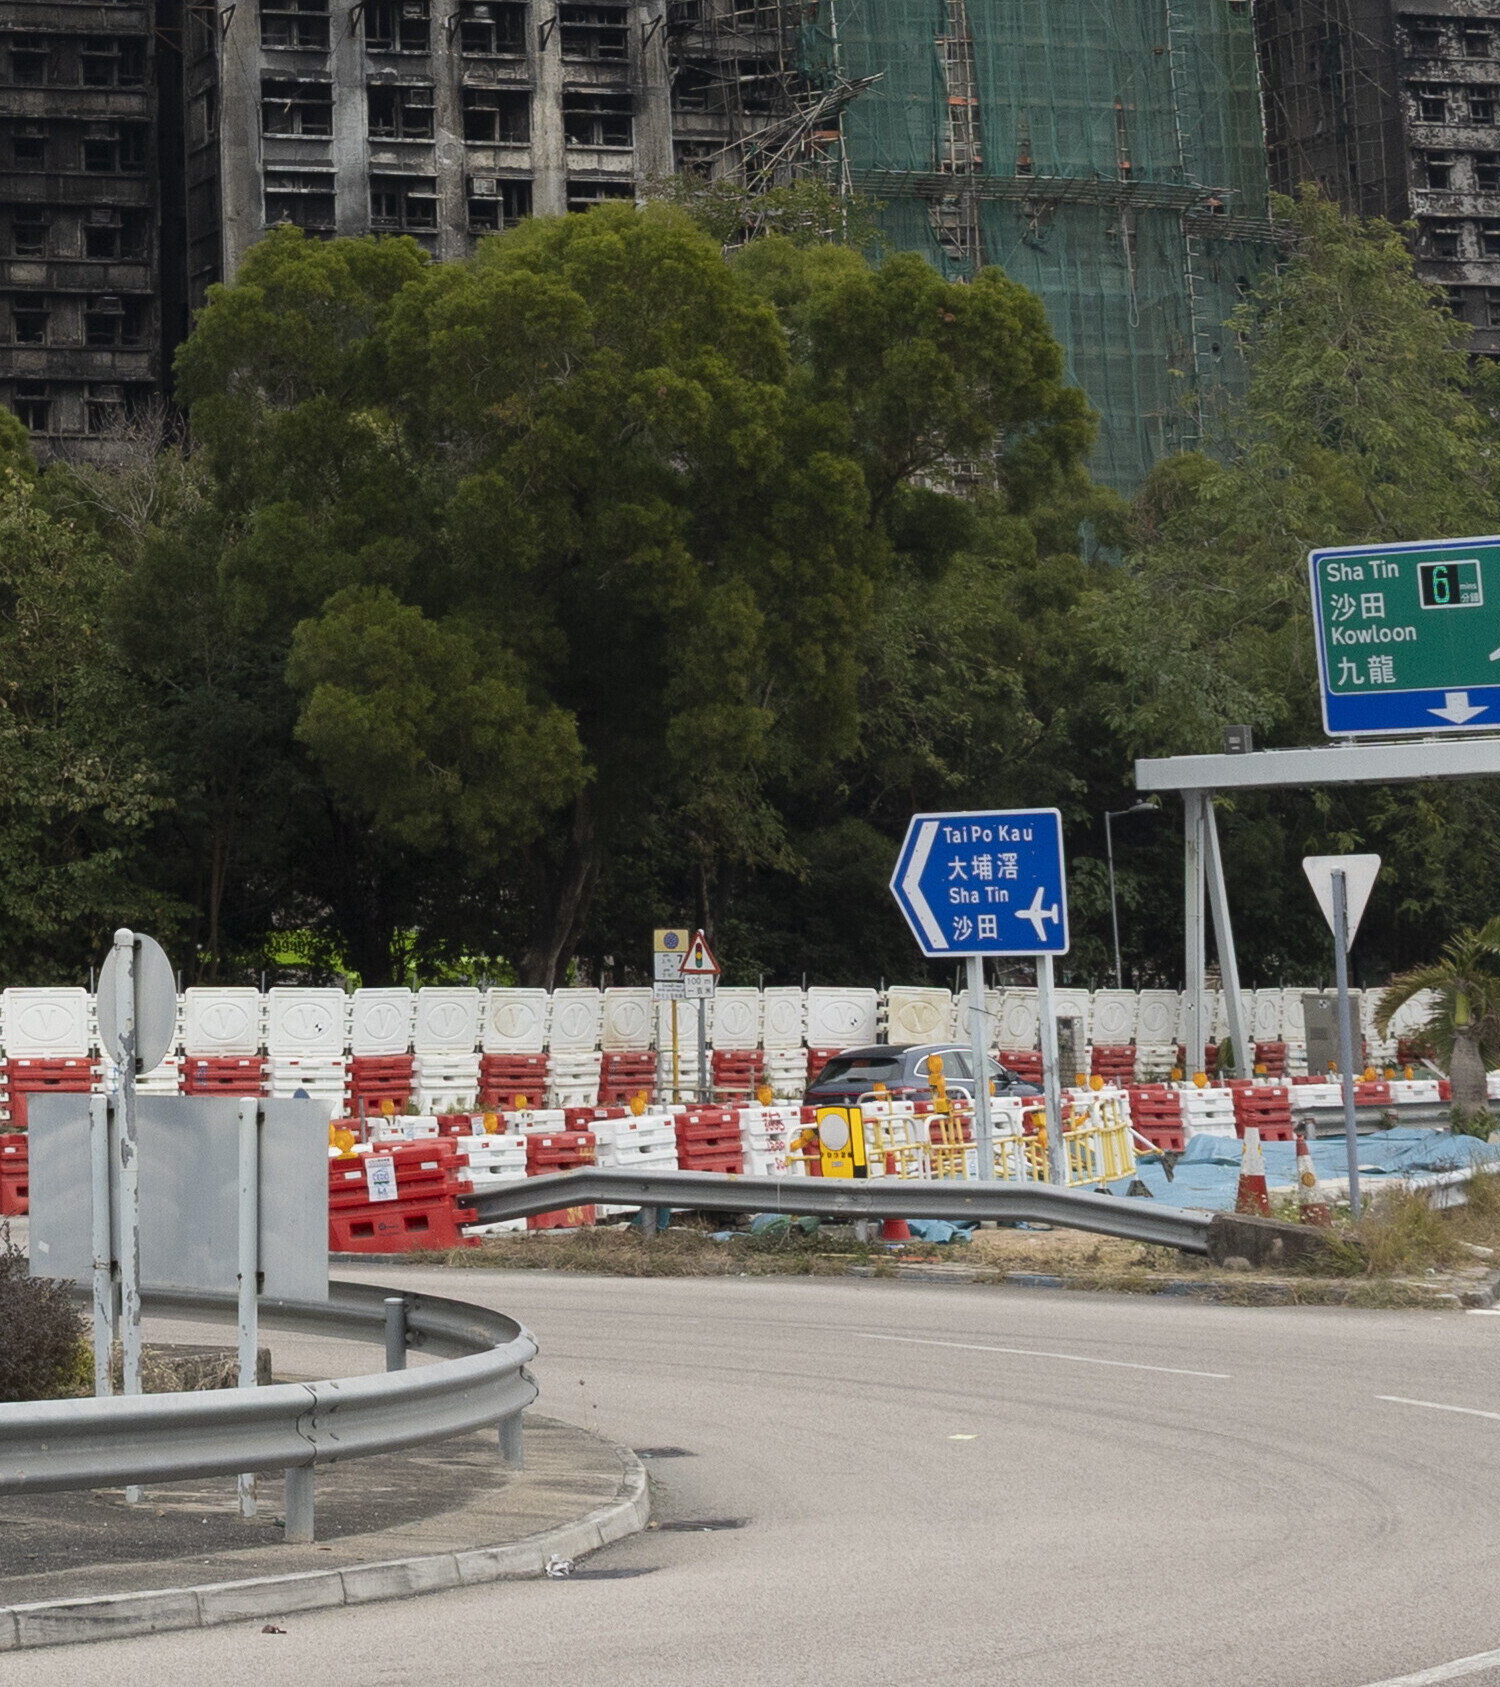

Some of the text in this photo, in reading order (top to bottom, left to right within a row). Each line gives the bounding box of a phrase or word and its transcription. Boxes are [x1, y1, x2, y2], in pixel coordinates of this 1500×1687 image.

[1326, 560, 1400, 583] Sha Tin
[1432, 565, 1450, 604] 6
[1459, 581, 1478, 591] mins
[1330, 591, 1386, 622] 沙田
[1331, 624, 1418, 646] Kowloon
[1337, 654, 1397, 686] 九龍
[943, 824, 1034, 844] Tai Po Kau
[947, 852, 1019, 882] 大埔滘
[949, 886, 1010, 904] Sha Tin
[953, 914, 999, 941] 沙田
[687, 977, 701, 985] 100
